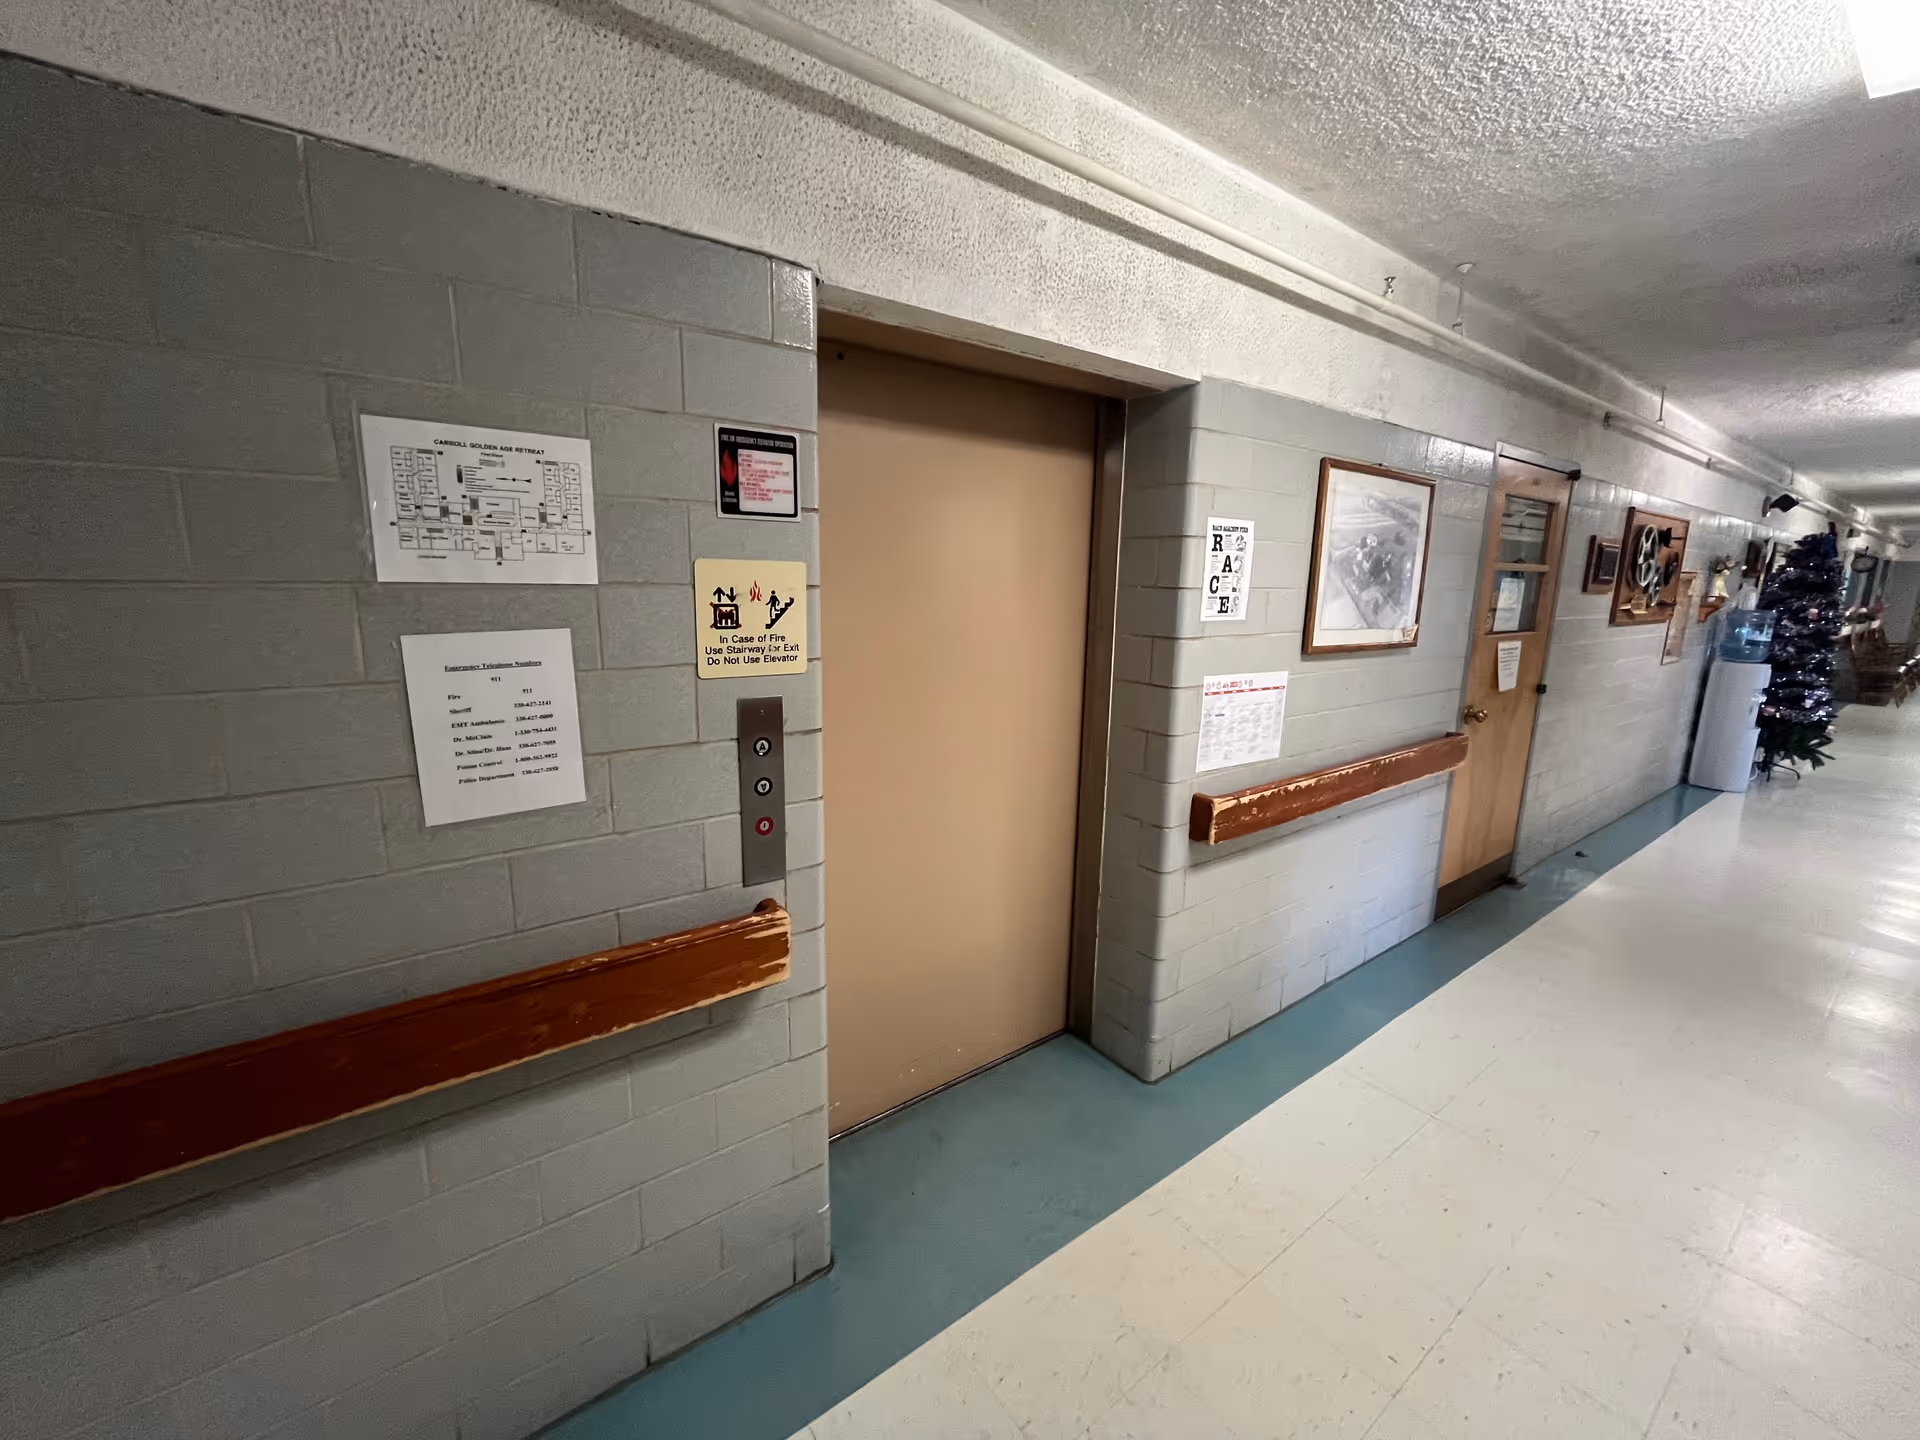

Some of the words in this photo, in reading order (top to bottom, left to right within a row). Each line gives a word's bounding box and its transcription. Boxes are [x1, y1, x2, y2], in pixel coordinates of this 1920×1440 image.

[434, 439, 467, 447] CARROLL
[469, 442, 498, 451] GOLDEN
[515, 447, 544, 455] RETREAT
[1211, 534, 1224, 552] R
[1222, 555, 1233, 573] A
[1209, 575, 1220, 594] C
[1217, 596, 1230, 614] E
[719, 635, 728, 644] In
[731, 635, 754, 643] Case
[757, 634, 766, 642] of
[769, 634, 786, 642] Fire
[705, 646, 723, 655] Use
[727, 645, 765, 655] Stairway
[784, 644, 799, 652] Exit
[707, 657, 720, 665] Do
[724, 656, 740, 664] Not
[743, 655, 760, 664] Use
[764, 654, 798, 663] Elevator
[470, 719, 505, 727] Ambulance
[479, 760, 503, 768] Control
[479, 772, 515, 783] Department
